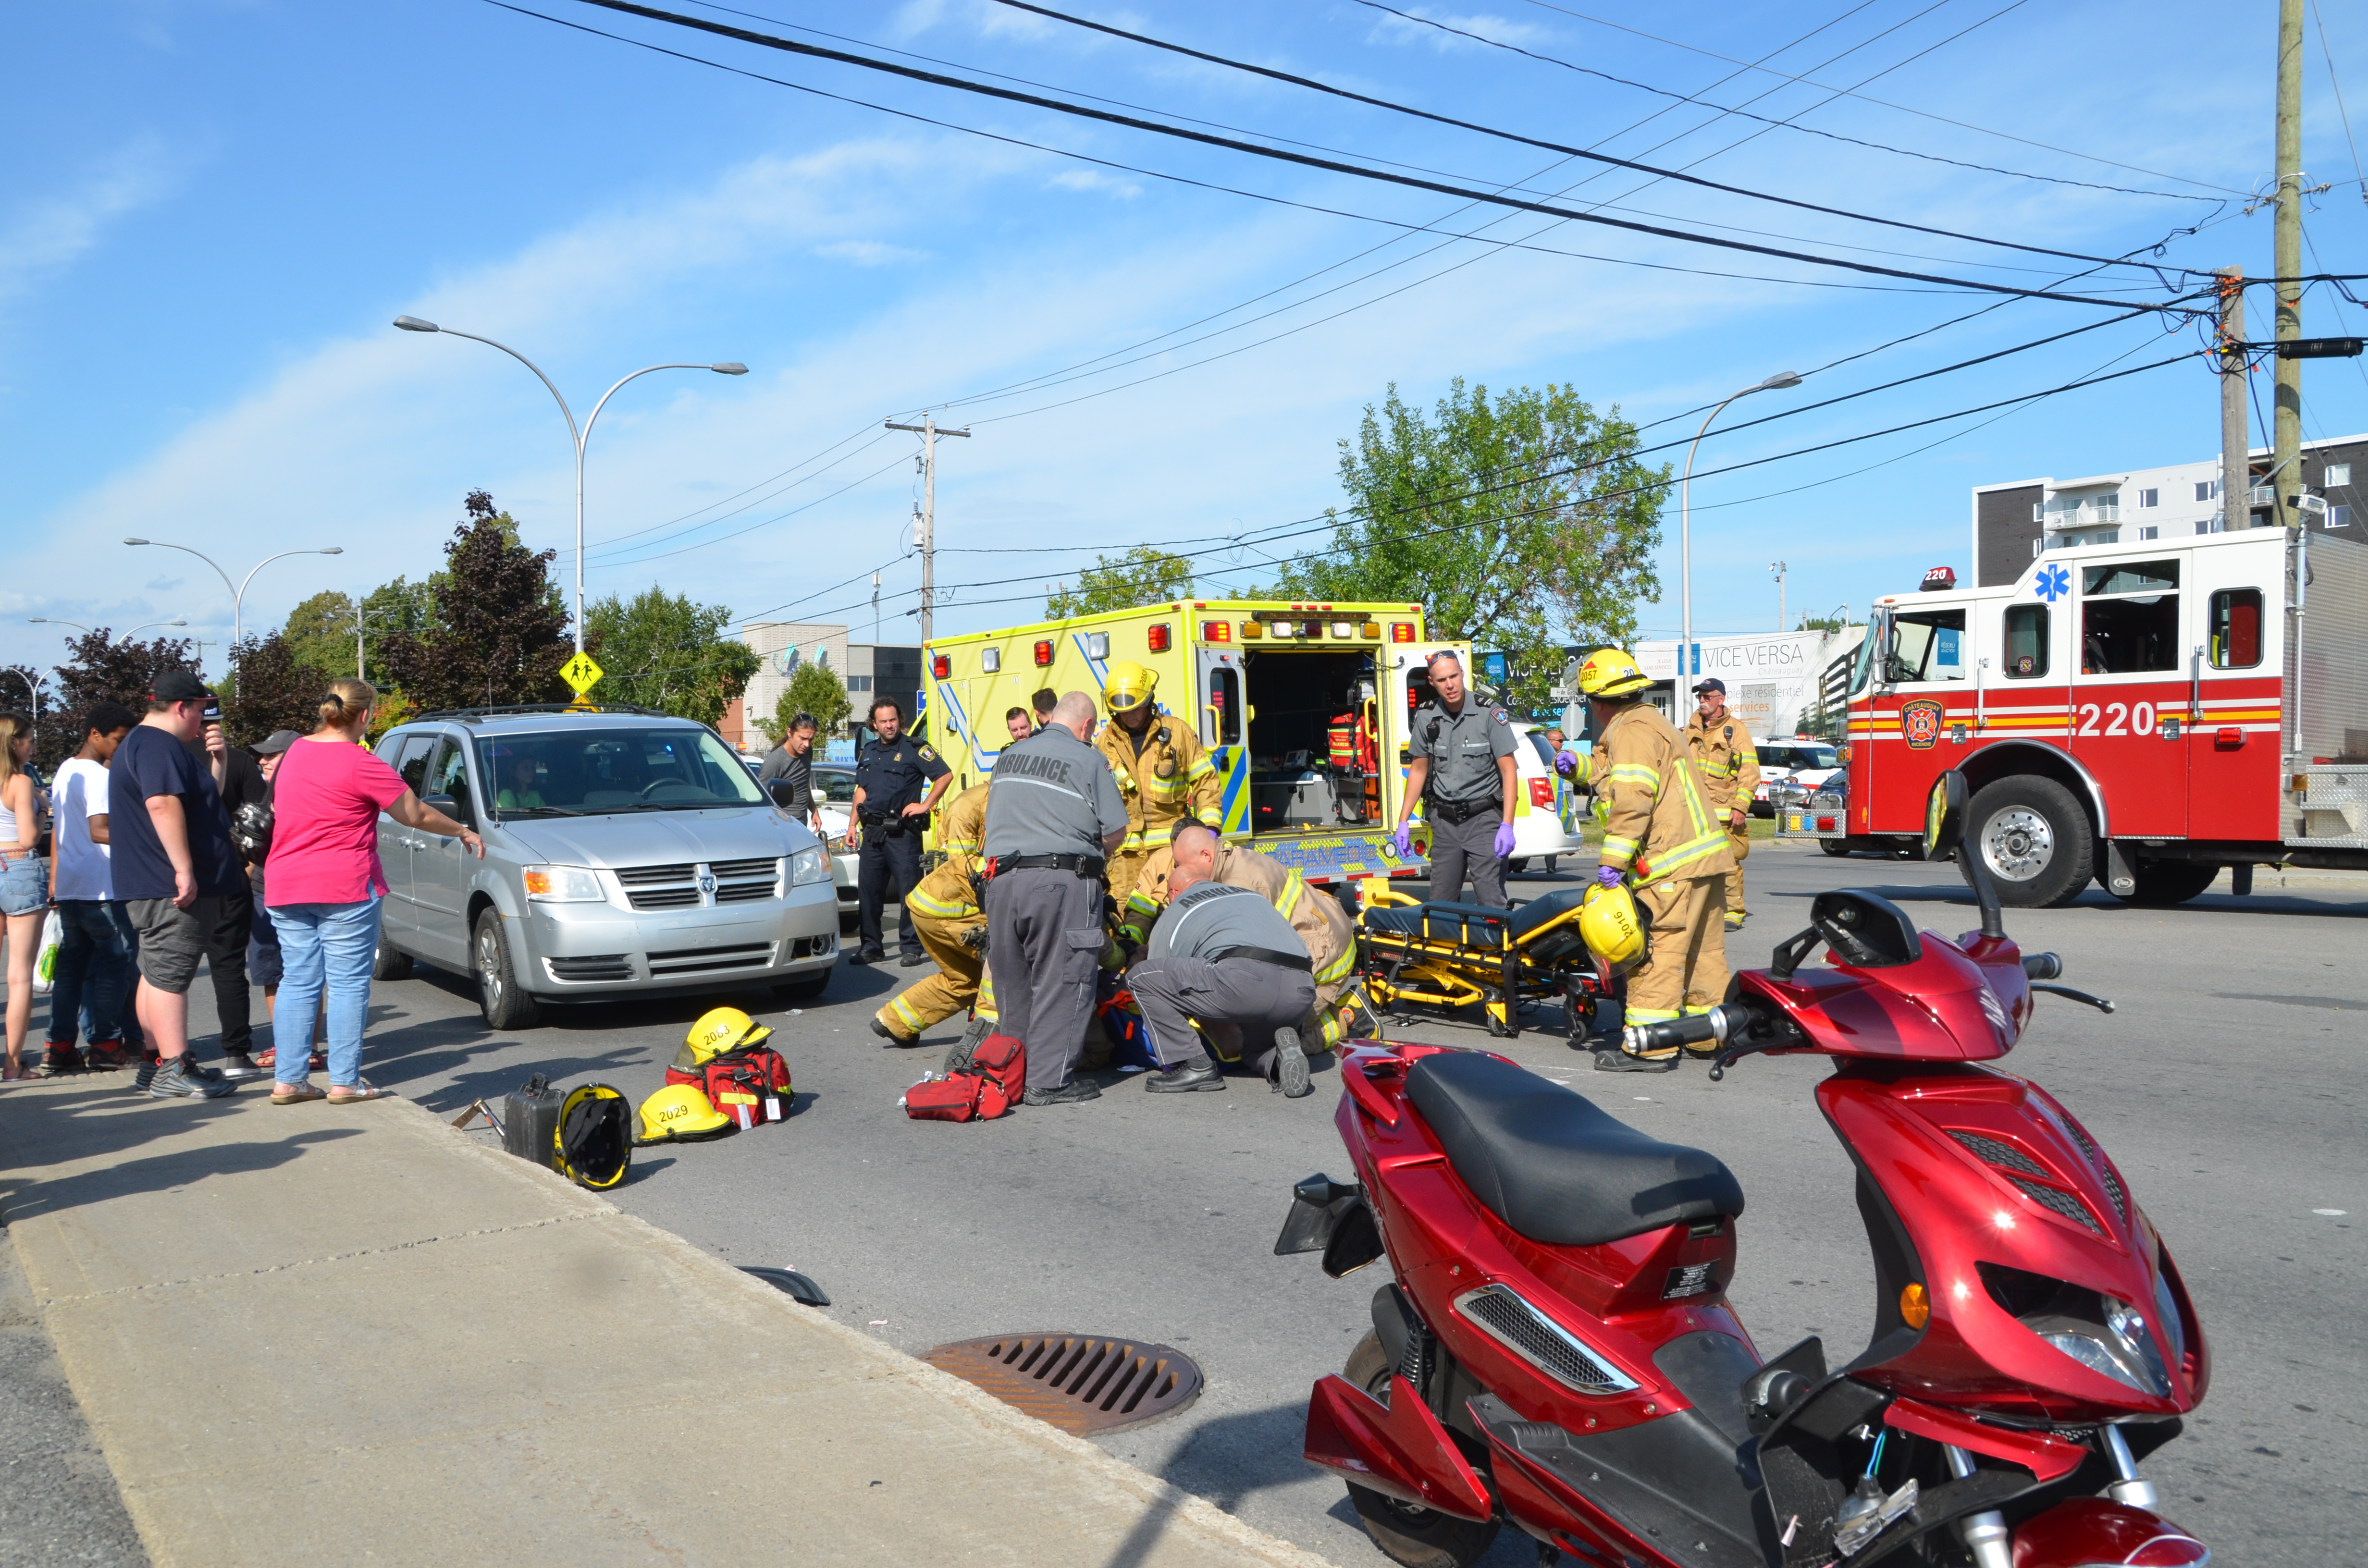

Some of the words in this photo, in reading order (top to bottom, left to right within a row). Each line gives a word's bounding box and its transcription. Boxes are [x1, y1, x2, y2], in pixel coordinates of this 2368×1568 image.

[1925, 569, 1947, 581] 220
[1704, 648, 1741, 668] VICE
[1745, 644, 1804, 665] VERSA
[1581, 670, 1597, 682] 2057
[1727, 687, 1752, 701] plexe
[1755, 685, 1804, 697] résidentiel
[1729, 701, 1769, 712] services
[1904, 703, 1940, 712] CHÂTEAUGUAY
[2078, 701, 2154, 736] 220
[1614, 911, 1633, 938] 2016
[703, 1025, 730, 1046] 2083
[659, 1105, 688, 1123] 2029
